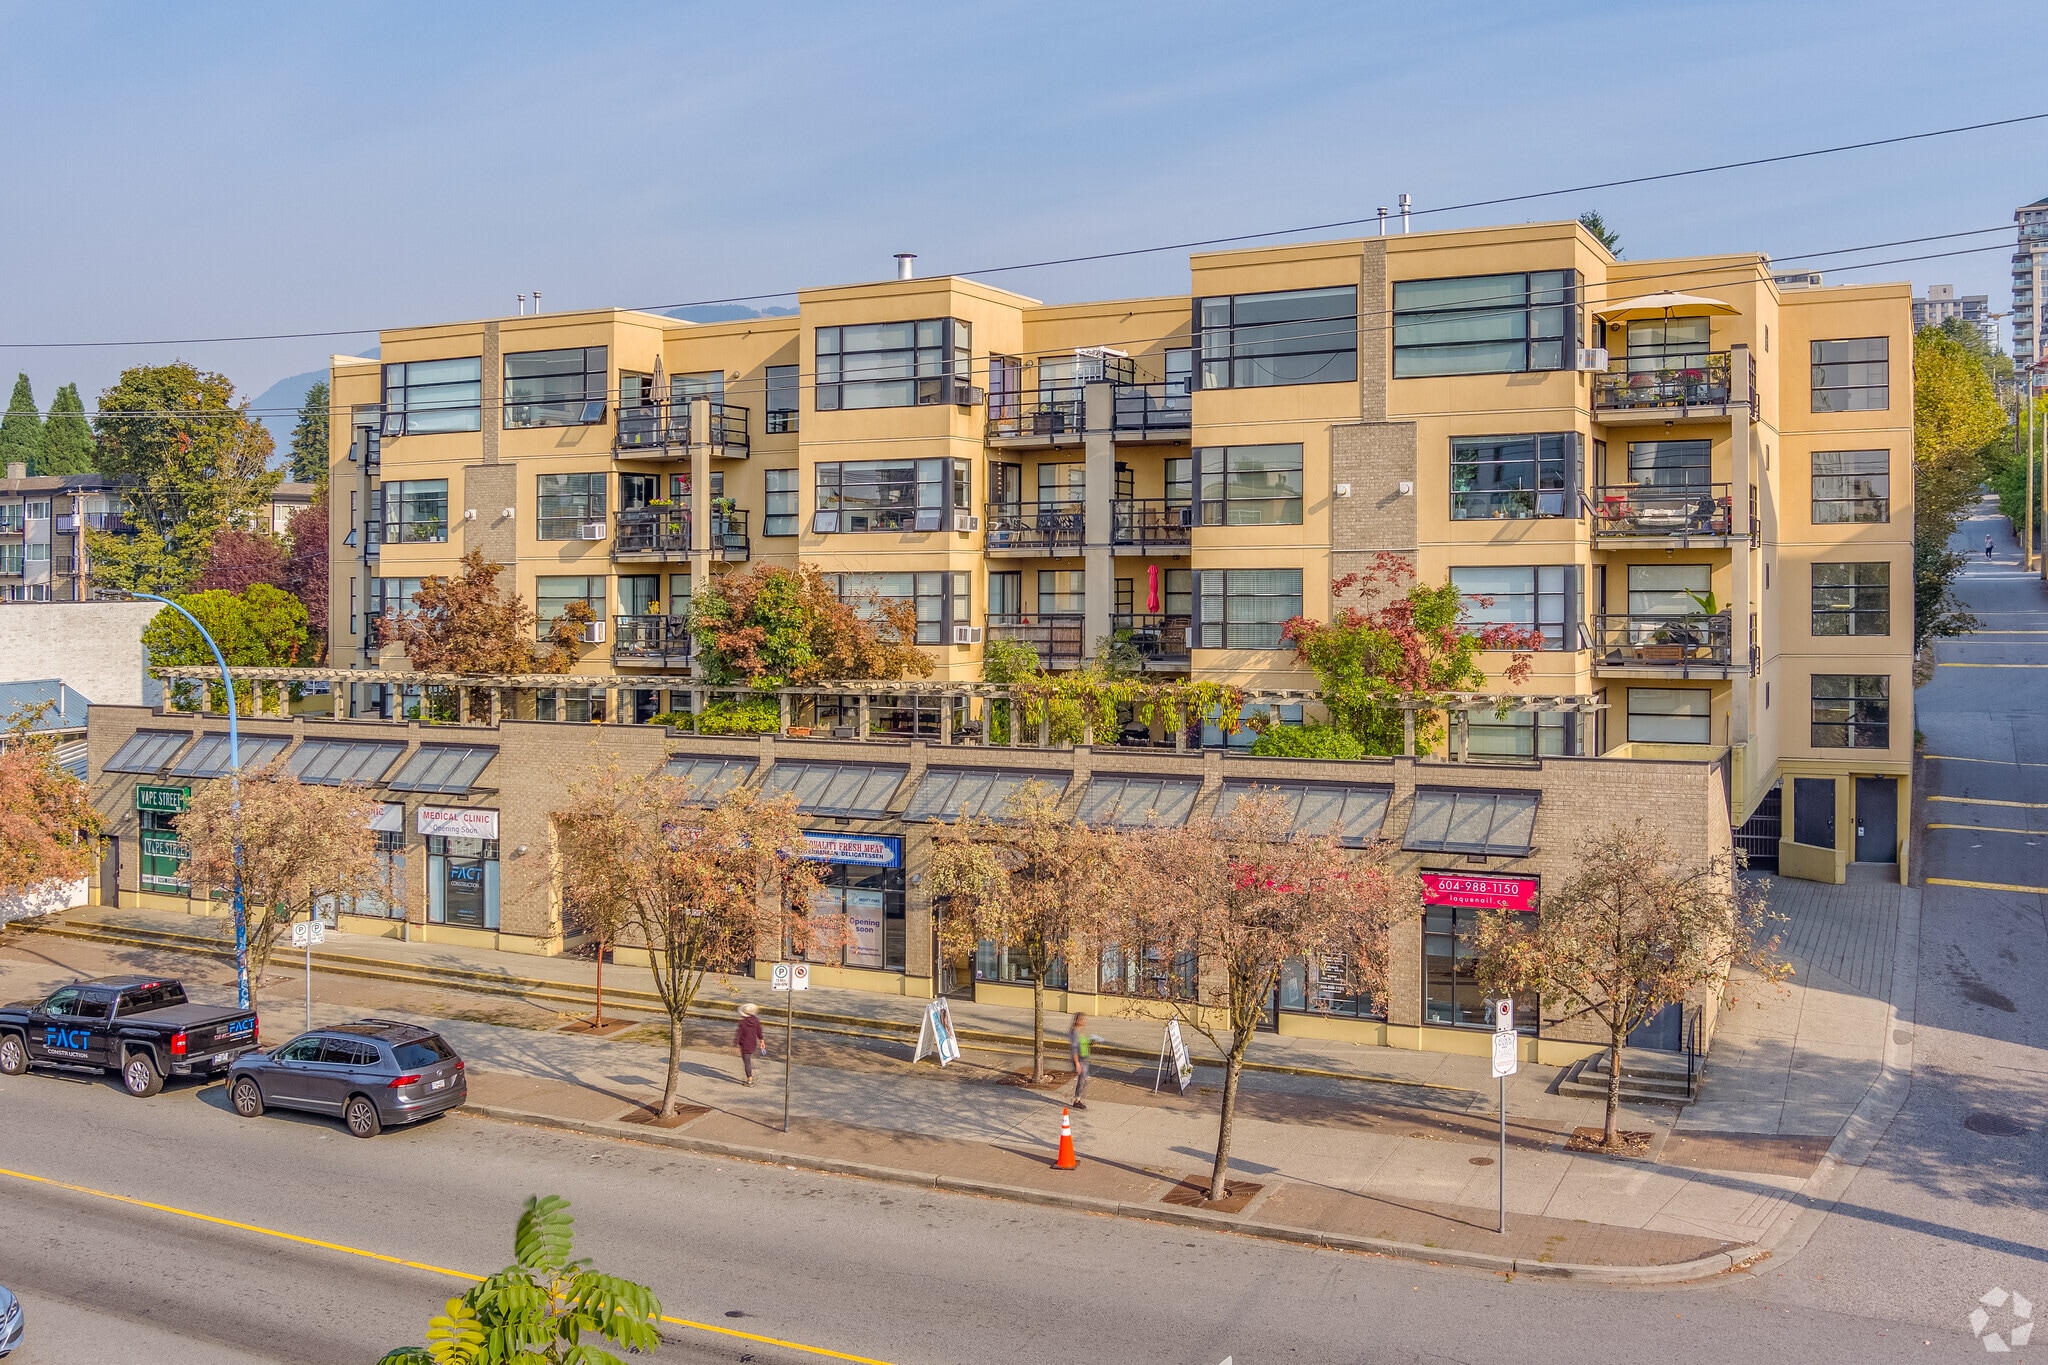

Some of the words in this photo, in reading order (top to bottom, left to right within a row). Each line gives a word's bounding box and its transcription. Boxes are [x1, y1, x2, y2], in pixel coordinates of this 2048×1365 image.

[141, 790, 157, 805] VAPE
[158, 793, 181, 807] STREET
[423, 811, 458, 821] MEDICAL
[463, 814, 490, 823] CLINIC
[433, 824, 459, 834] Opening
[461, 826, 478, 834] Soon
[838, 842, 862, 852] FRESH
[864, 844, 884, 854] MEAT
[841, 851, 884, 859] DELICATESSEN
[451, 866, 482, 880] FACT
[1438, 880, 1519, 895] 604-988-1150
[849, 917, 880, 928] Opening
[855, 925, 874, 933] soon
[229, 1016, 255, 1033] FACT
[46, 1027, 91, 1050] FACT
[47, 1048, 89, 1059] CONSTRUCTION
